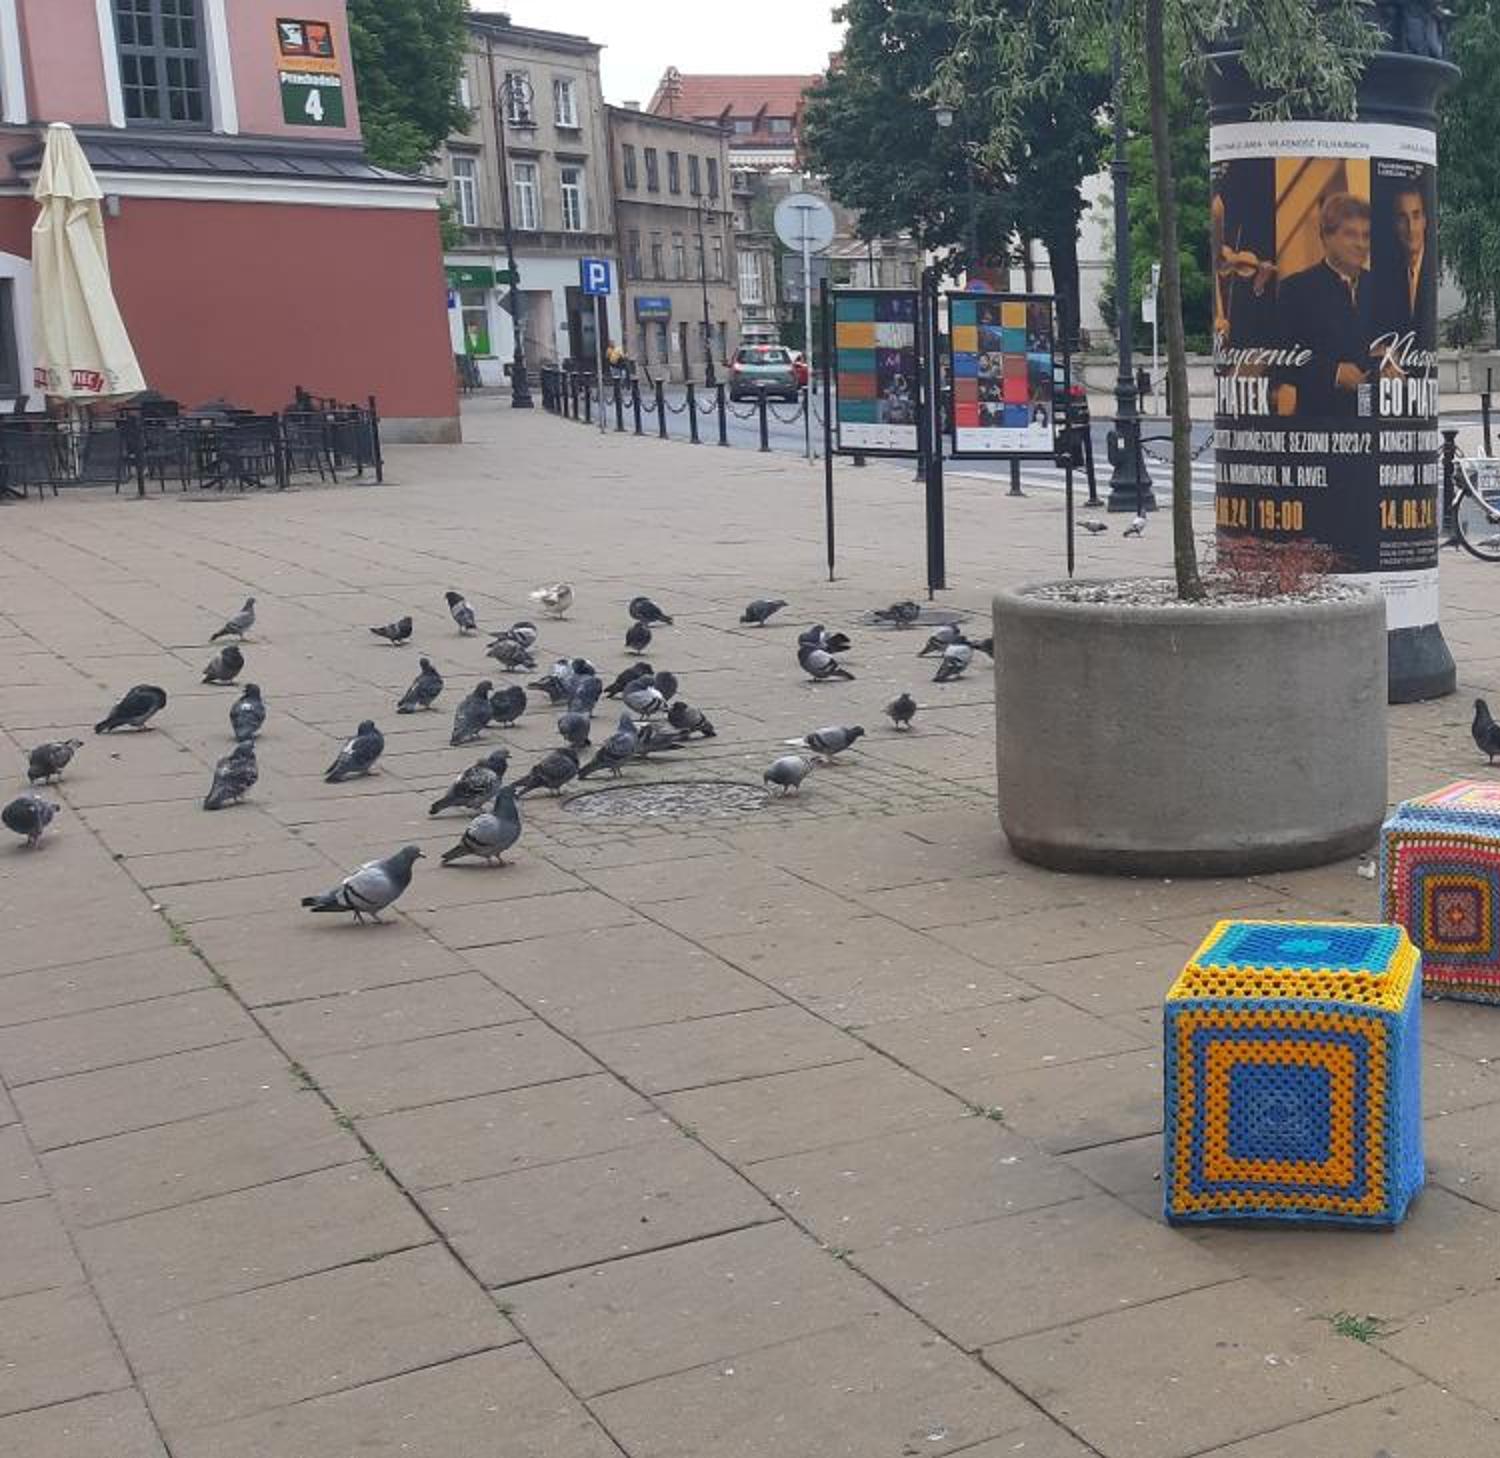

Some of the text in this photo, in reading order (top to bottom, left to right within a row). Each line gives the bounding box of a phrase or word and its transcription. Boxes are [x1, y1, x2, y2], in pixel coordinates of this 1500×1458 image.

[305, 88, 324, 121] 4
[1379, 377, 1403, 416] CO
[1288, 431, 1329, 453] SEZONU
[1297, 466, 1328, 488] RAVEL
[1259, 499, 1303, 530] 19:00
